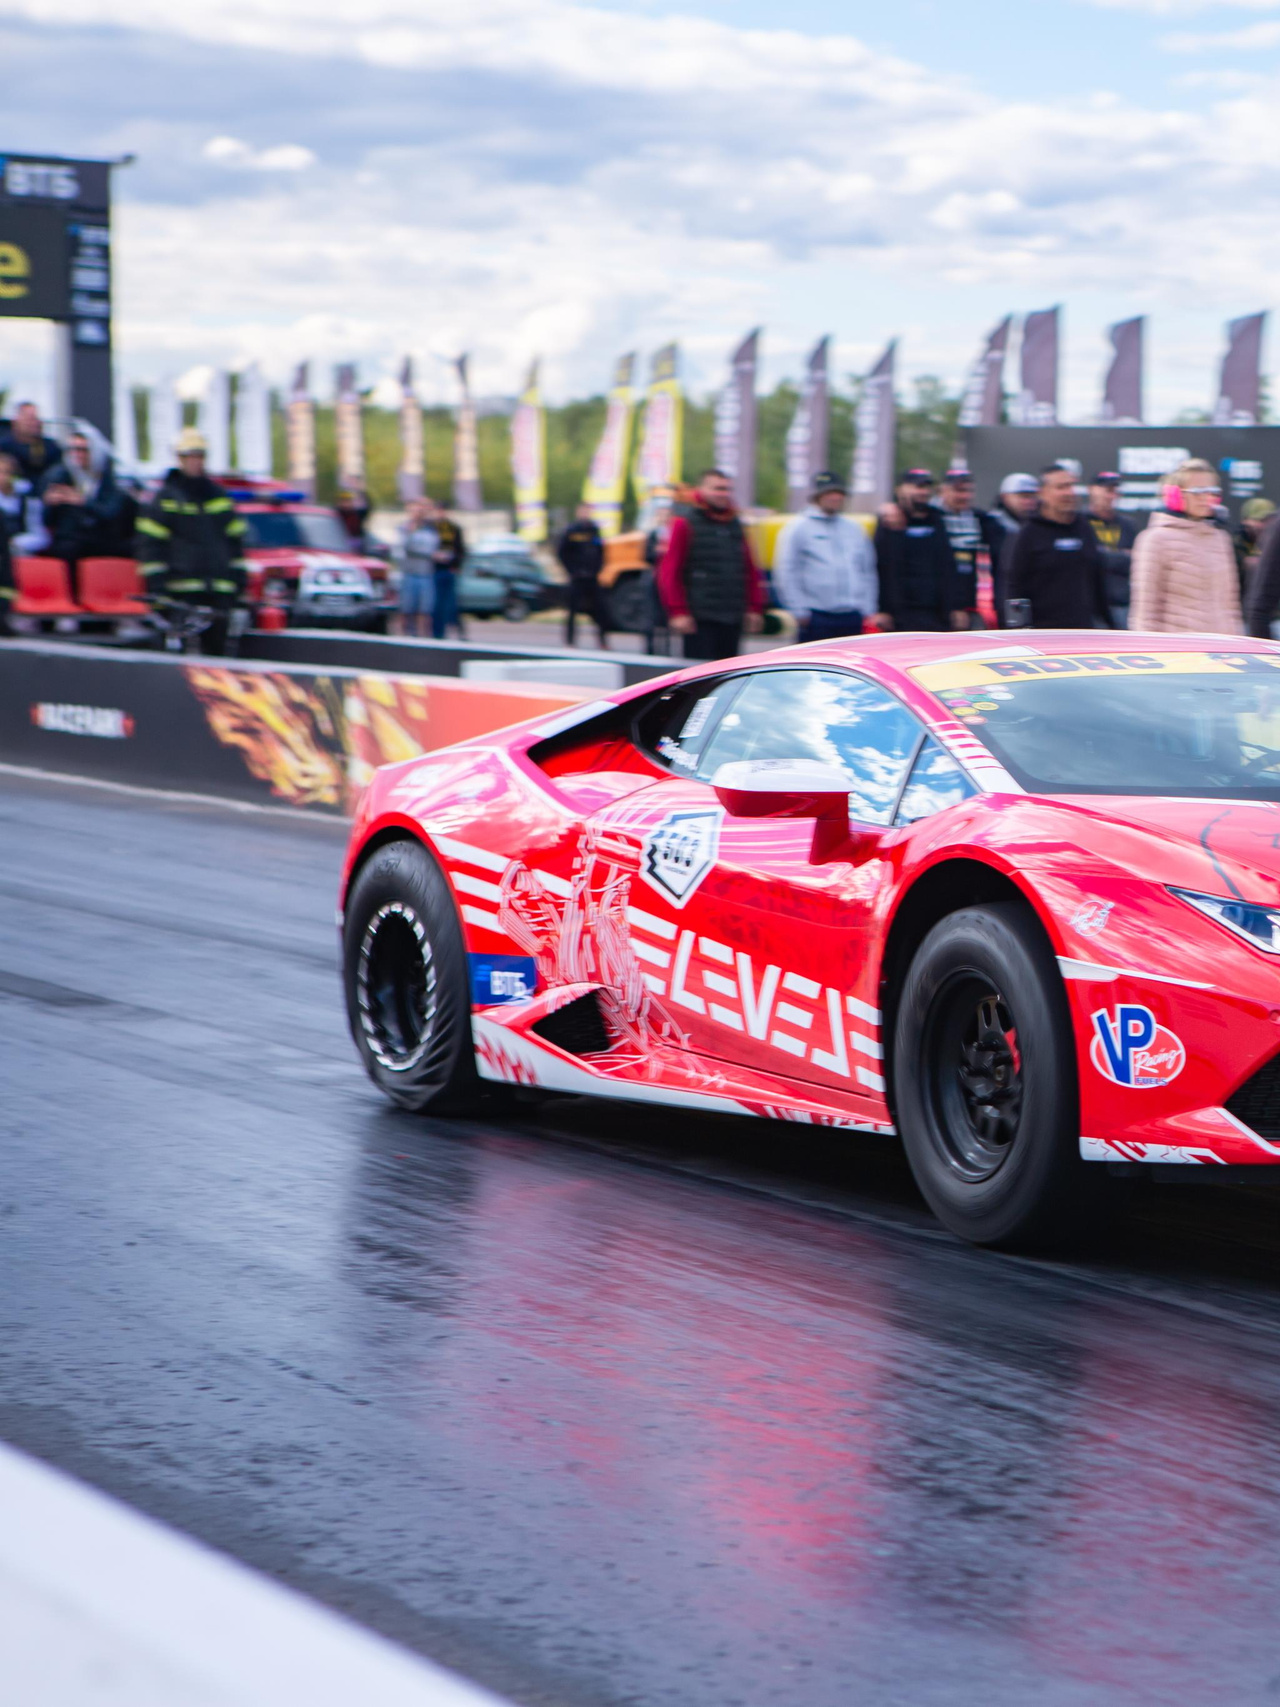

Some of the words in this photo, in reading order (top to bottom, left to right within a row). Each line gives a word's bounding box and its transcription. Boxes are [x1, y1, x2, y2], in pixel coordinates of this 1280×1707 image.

[980, 656, 1165, 677] RDRC
[1090, 1004, 1156, 1086] VP
[1134, 1048, 1182, 1075] Racing
[1134, 1077, 1168, 1087] FUELS
